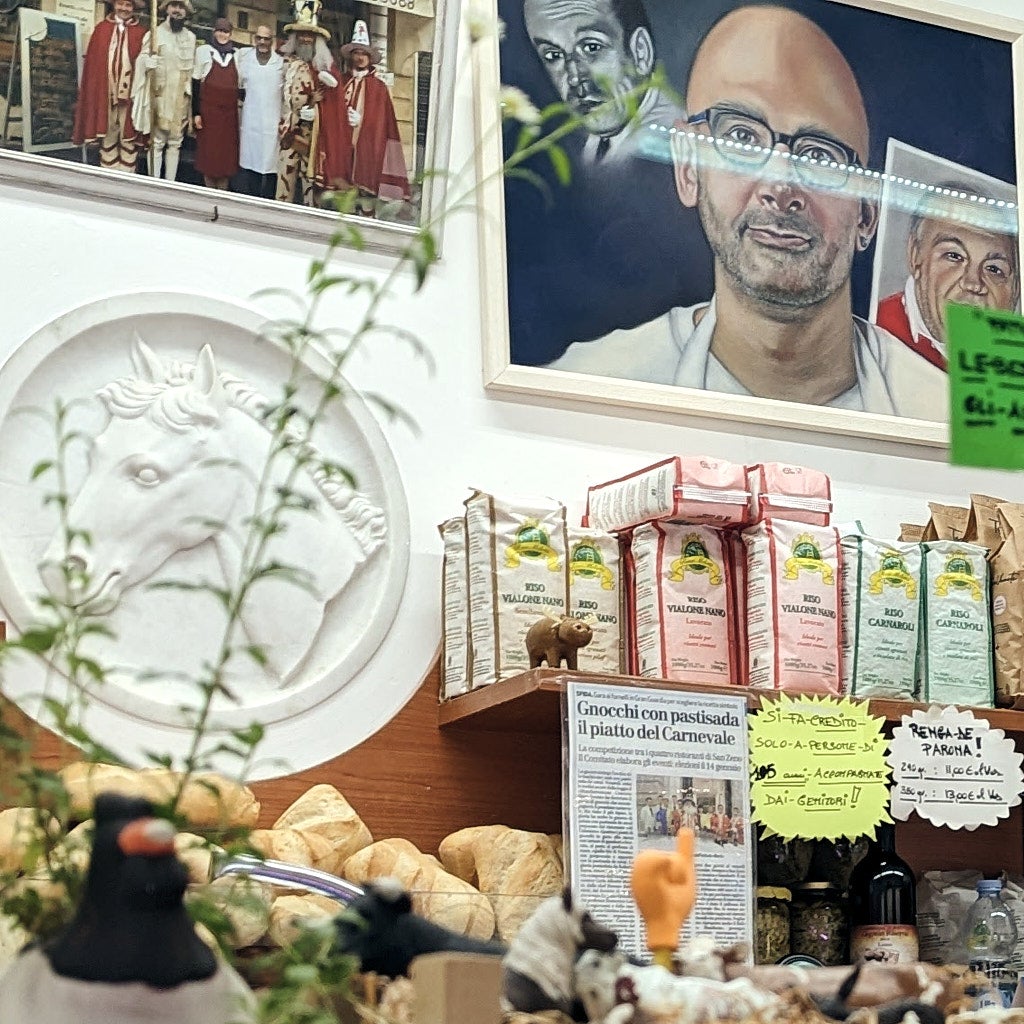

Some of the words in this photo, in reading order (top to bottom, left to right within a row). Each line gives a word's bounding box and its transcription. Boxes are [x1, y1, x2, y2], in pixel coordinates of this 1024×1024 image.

[525, 583, 546, 593] RISO
[502, 594, 541, 605] VIALONE
[542, 596, 564, 607] NANO
[578, 600, 598, 610] RISO
[803, 594, 821, 604] RISO
[667, 605, 704, 615] VIALONE
[705, 607, 726, 618] NANO
[781, 605, 817, 615] VIALONE
[818, 608, 836, 619] NANO
[884, 607, 903, 618] RISO
[950, 609, 970, 619] RISO
[868, 618, 915, 632] CARNAROLI
[936, 619, 984, 632] CARNAROLI
[577, 701, 639, 720] Gnocchi
[641, 709, 668, 722] con
[671, 708, 740, 728] pastisada
[578, 720, 587, 735] il
[590, 722, 635, 740] piatto
[637, 724, 660, 740] del
[662, 727, 736, 746] Carnevale
[578, 744, 588, 752] La
